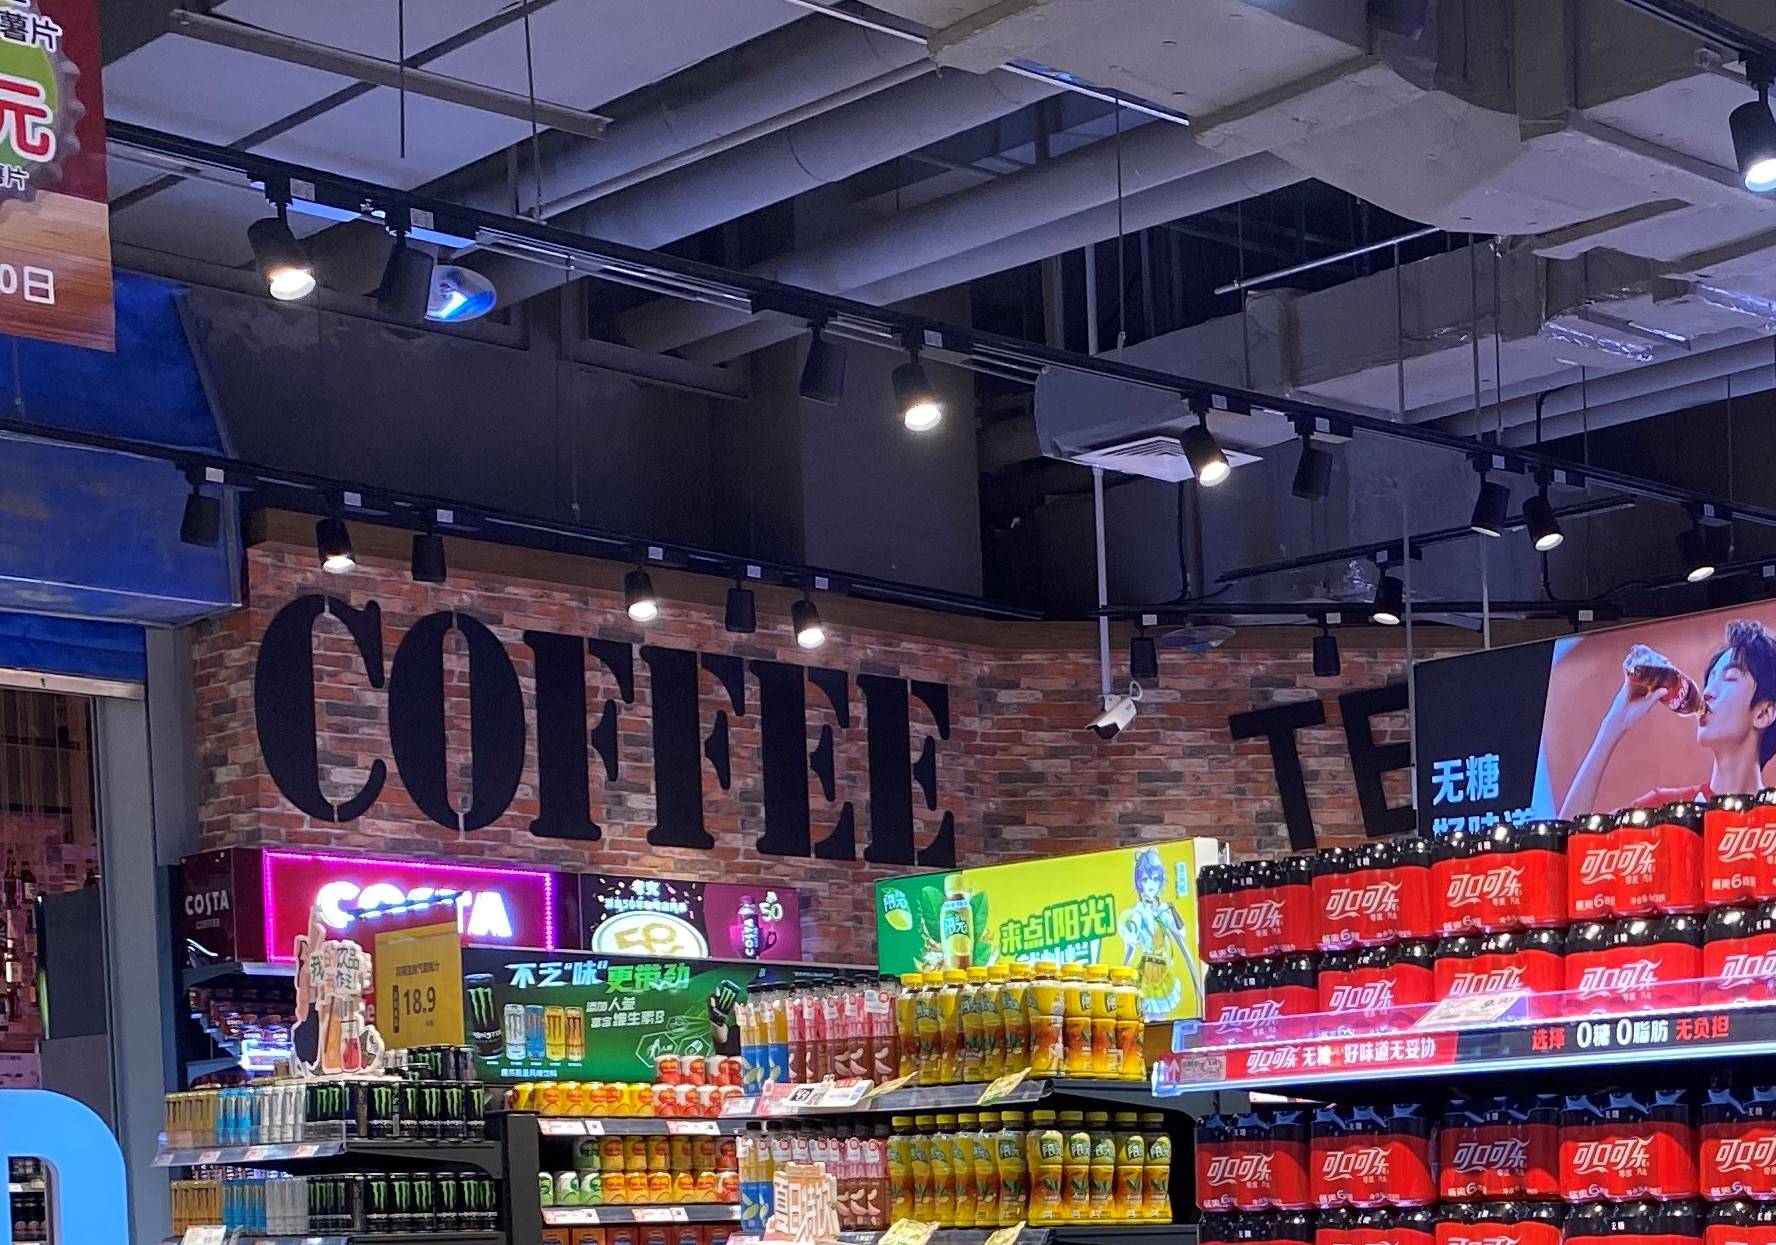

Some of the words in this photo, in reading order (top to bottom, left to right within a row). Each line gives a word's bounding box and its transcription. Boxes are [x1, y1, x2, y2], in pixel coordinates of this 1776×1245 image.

[254, 594, 956, 867] COFFEE
[1432, 754, 1500, 805] 无糖
[1580, 842, 1660, 884] 可口可乐
[185, 890, 230, 917] COSTA
[1325, 881, 1402, 920] 可口可乐
[1446, 866, 1525, 907] 可口可乐
[1211, 900, 1286, 937] 可口可乐
[1328, 978, 1396, 1015] 可口可乐
[1578, 960, 1663, 1000] 可口可乐
[403, 986, 436, 1016] 18.9
[1531, 1027, 1566, 1050] 选择
[1577, 1020, 1610, 1048] 0糖
[1616, 1018, 1669, 1043] 0脂肪
[1676, 1015, 1730, 1040] 无负担
[1246, 1046, 1302, 1074] 可口可乐
[1302, 1048, 1332, 1066] 无糖
[1343, 1039, 1437, 1064] 好味道无妥协
[1323, 1147, 1391, 1178] 可口可乐
[1573, 1135, 1652, 1173] 可口可乐
